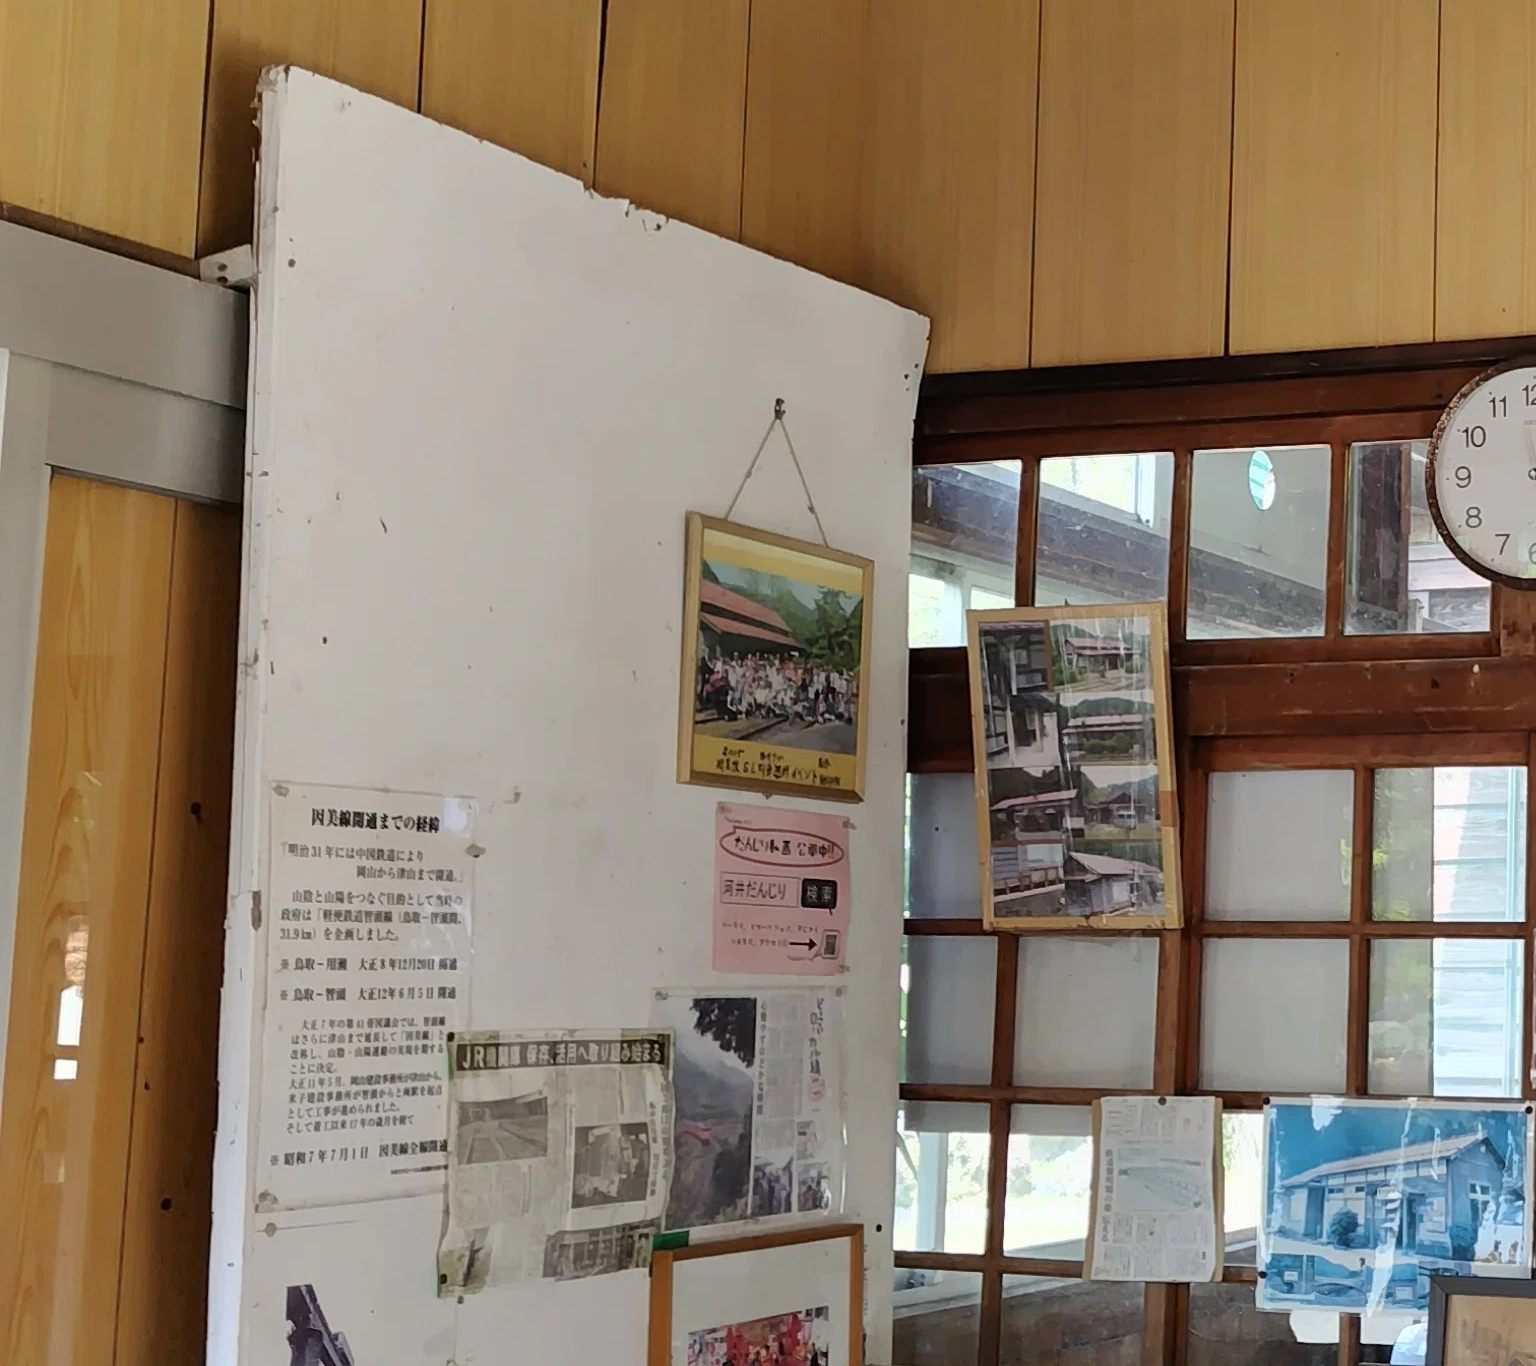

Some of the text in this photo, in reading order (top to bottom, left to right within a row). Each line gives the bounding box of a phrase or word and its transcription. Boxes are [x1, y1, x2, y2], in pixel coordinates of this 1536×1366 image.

[1488, 396, 1508, 418] 11
[1461, 425, 1487, 448] 10
[1454, 466, 1472, 488] 9
[1465, 506, 1482, 528] 8
[1494, 533, 1511, 555] 7
[311, 807, 440, 833] 因美線開通までの経緯
